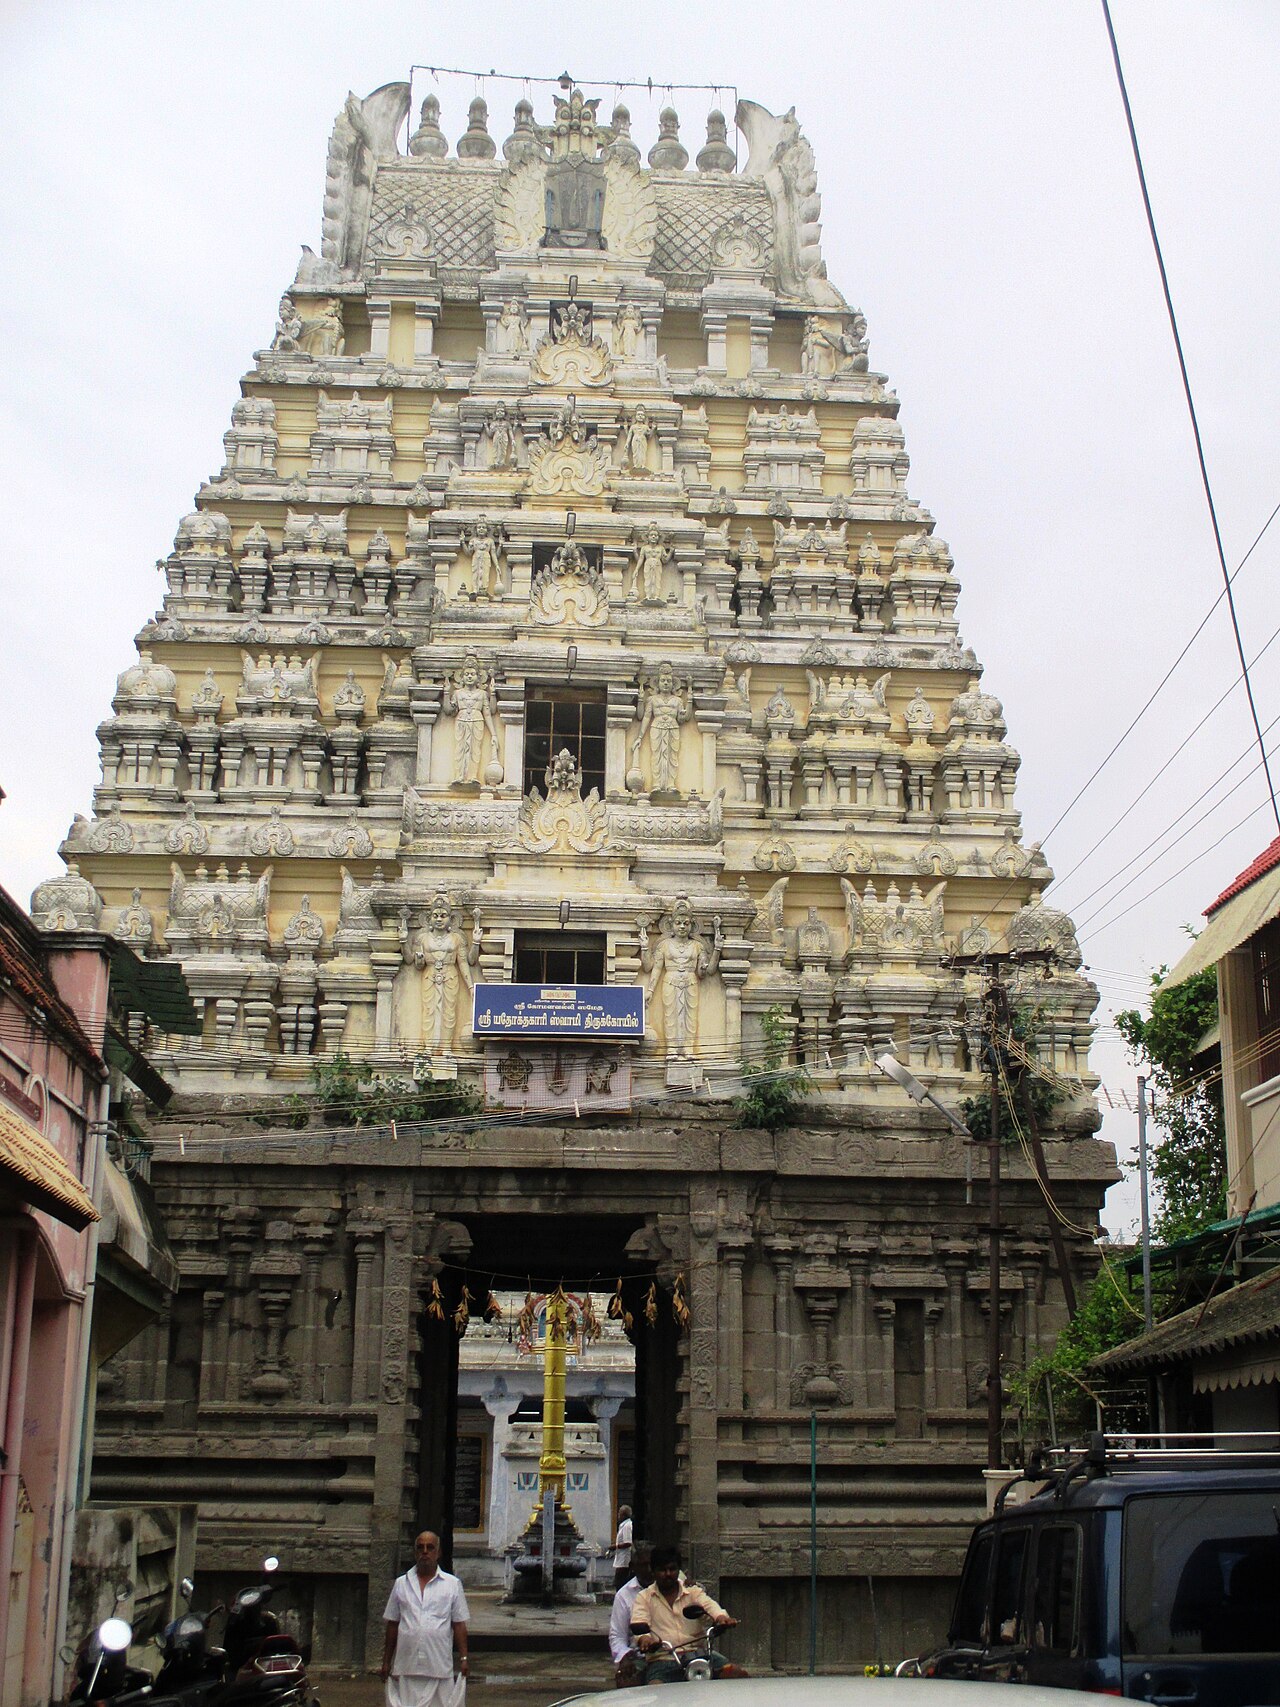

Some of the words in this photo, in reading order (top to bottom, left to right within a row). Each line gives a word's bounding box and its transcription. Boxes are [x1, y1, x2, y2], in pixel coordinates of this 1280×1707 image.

[493, 1011, 547, 1028] யதோக்தகாரி
[550, 1011, 581, 1026] ஸ்வாமி
[584, 1011, 639, 1029] திருக்கோயில்
